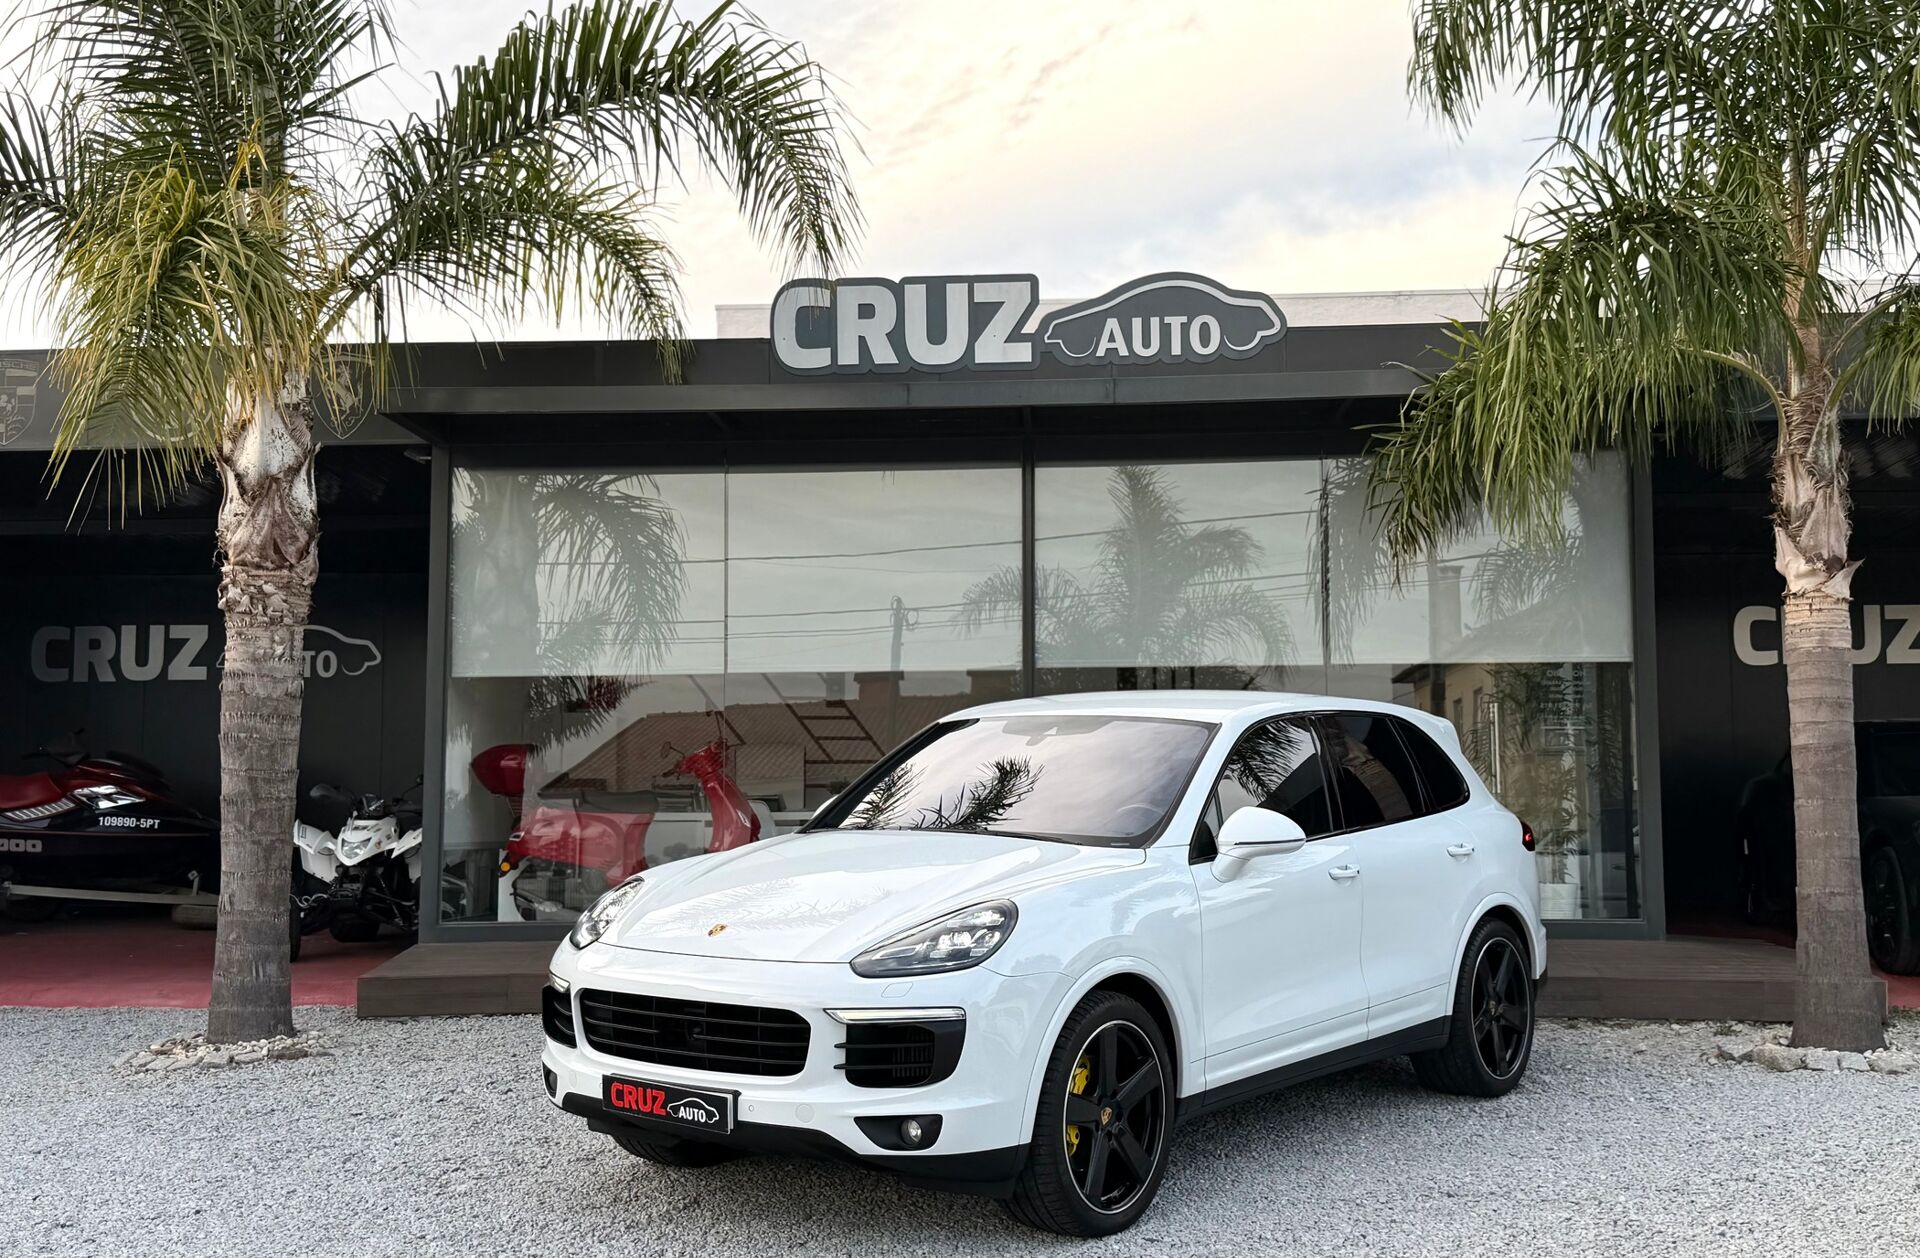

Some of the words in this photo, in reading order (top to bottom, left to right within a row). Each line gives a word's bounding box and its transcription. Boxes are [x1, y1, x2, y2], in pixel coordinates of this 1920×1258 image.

[773, 281, 1033, 369] CRUZ
[1096, 314, 1221, 358] AUTO
[31, 624, 209, 683] CRUZ
[1733, 604, 1920, 666] CUZ
[98, 816, 160, 829] 109890-5PT
[610, 1082, 667, 1116] CRUZ
[678, 1106, 706, 1123] AUTO
